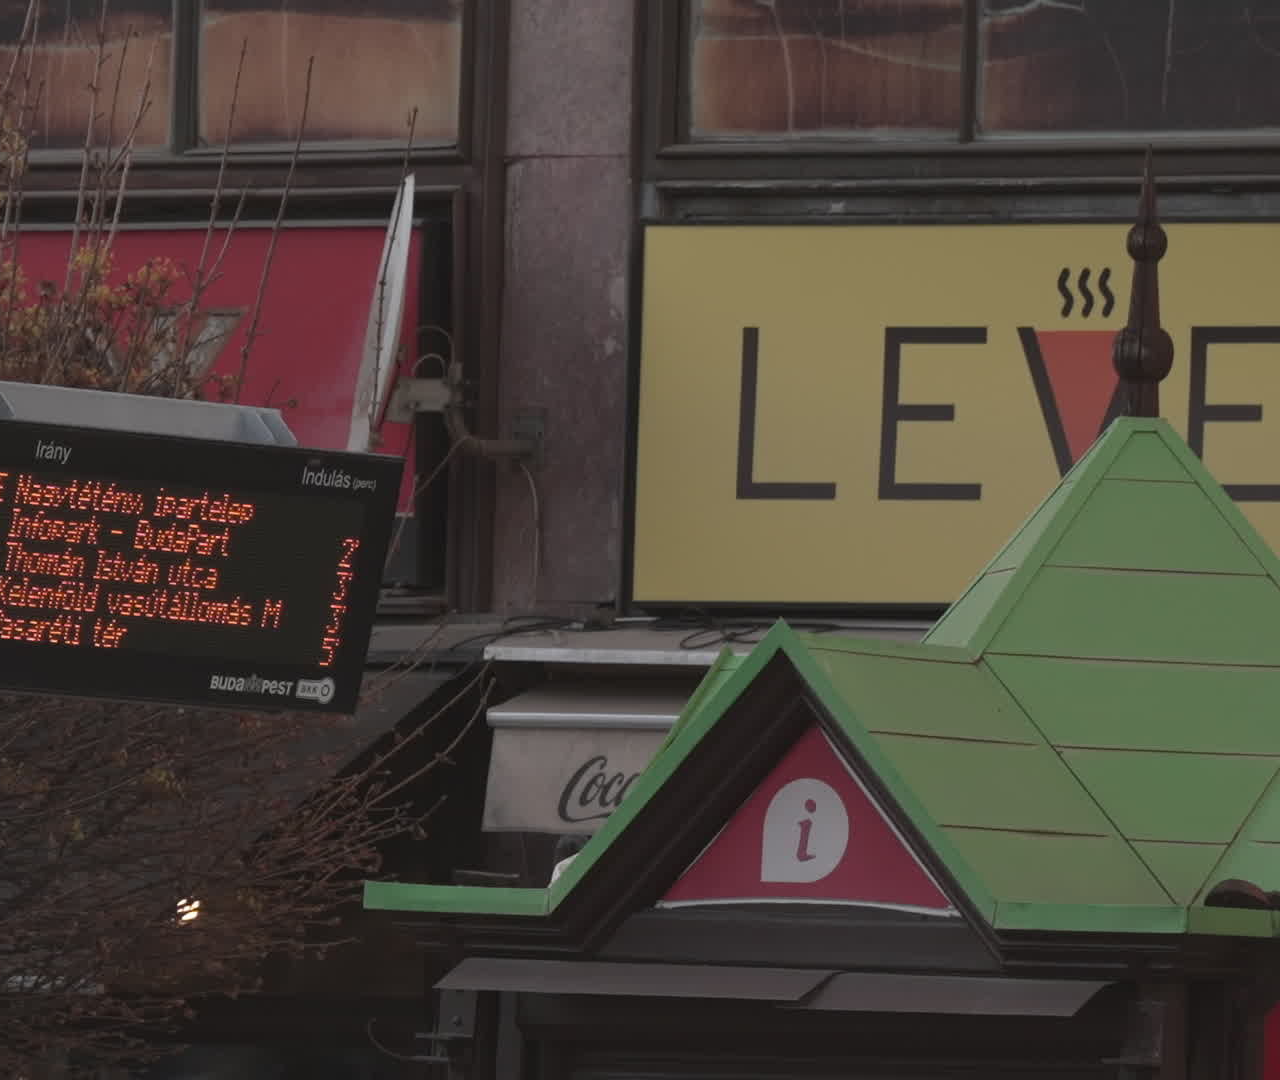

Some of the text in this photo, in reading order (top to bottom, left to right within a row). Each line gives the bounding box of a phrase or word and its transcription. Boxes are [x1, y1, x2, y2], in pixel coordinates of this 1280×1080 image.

[35, 440, 72, 464] Irány
[302, 466, 351, 488] Indulás
[153, 487, 255, 525] ipartelep
[8, 508, 100, 545] Infopark
[133, 520, 230, 556] BudaPart
[5, 541, 85, 577] Thomán
[92, 549, 159, 584] István
[167, 558, 218, 590] utca
[106, 588, 253, 626] vasútállomás
[260, 598, 283, 628] M
[93, 618, 128, 648] tér
